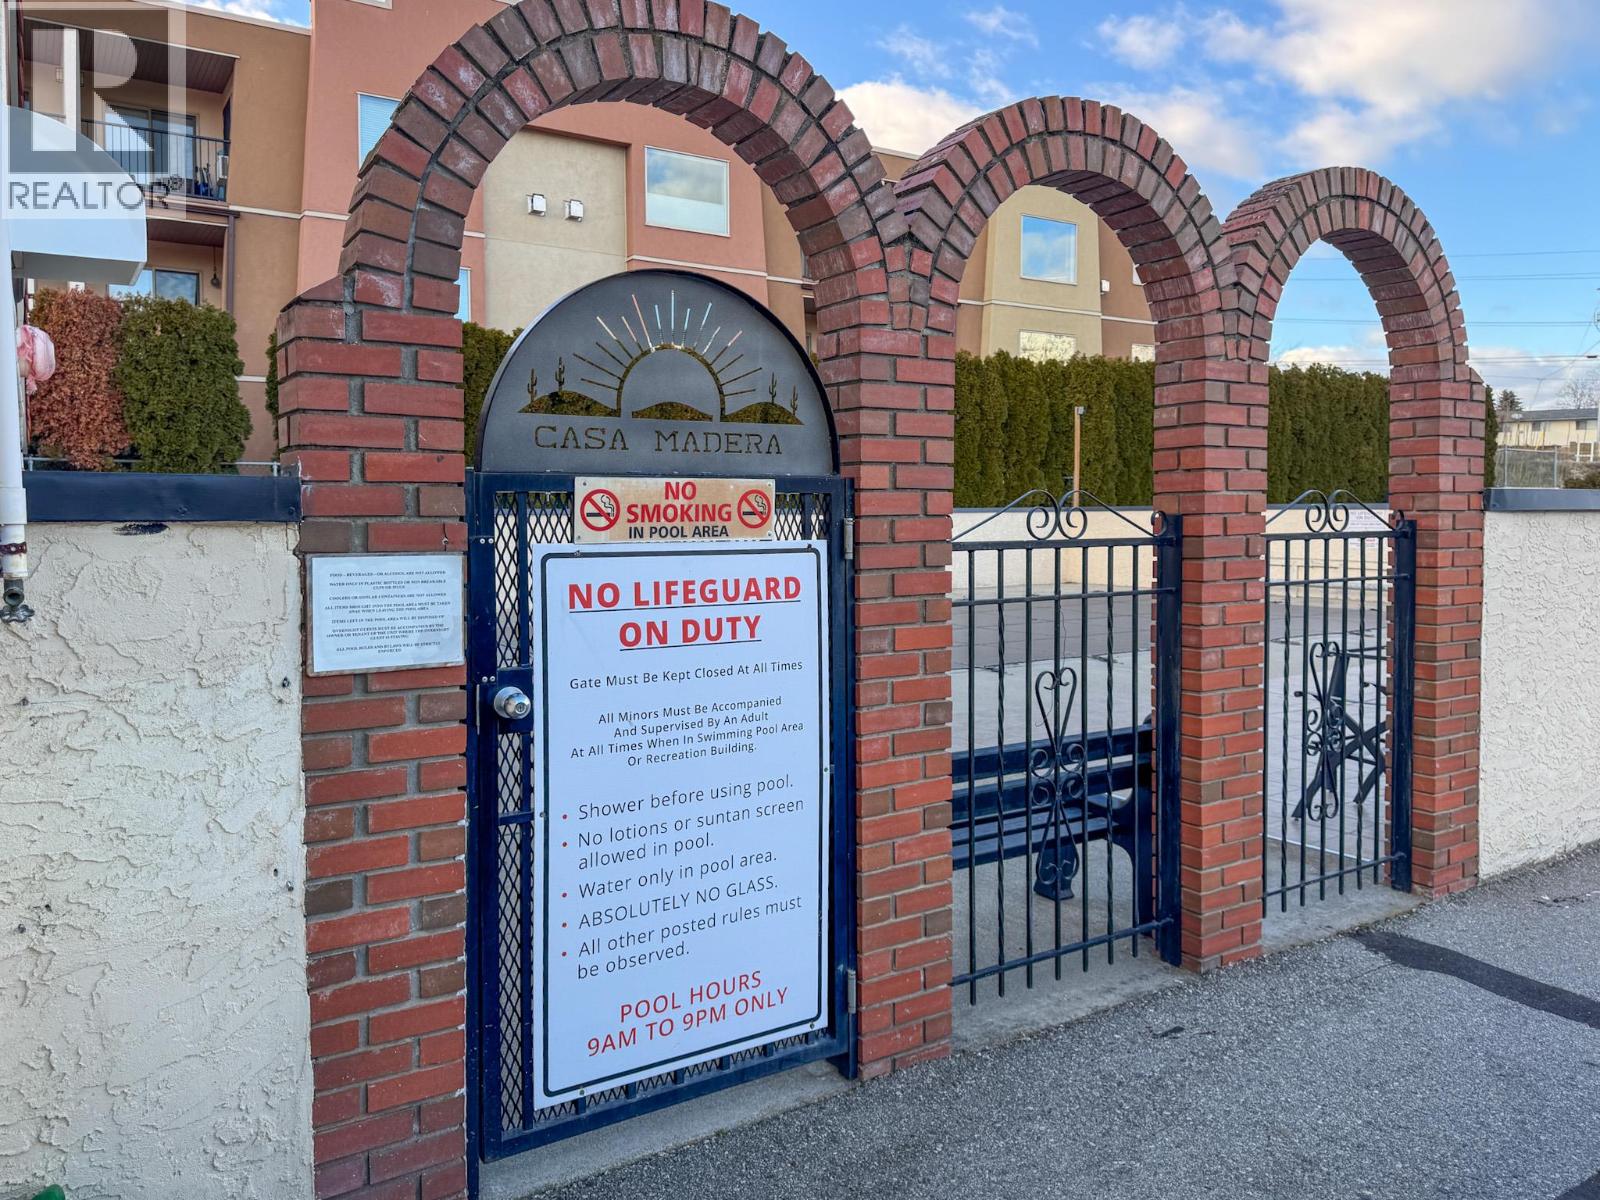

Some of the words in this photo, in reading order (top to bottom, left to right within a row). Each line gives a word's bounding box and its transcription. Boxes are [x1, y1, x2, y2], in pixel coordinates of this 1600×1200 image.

[535, 426, 629, 450] CASA
[654, 430, 782, 454] MADERA
[664, 481, 697, 501] NO
[626, 503, 731, 523] SMOKING
[629, 526, 644, 539] IN
[650, 526, 687, 538] POOL
[692, 526, 729, 537] AREA
[568, 583, 619, 608] NO
[634, 577, 799, 605] LIFEGUARD
[620, 622, 667, 647] ON
[682, 617, 759, 641] DUTY
[570, 678, 601, 689] Gate
[606, 675, 638, 686] Must
[644, 673, 658, 683] Be
[663, 670, 690, 683] Kept
[695, 665, 733, 678] Closed
[738, 665, 749, 674] At
[753, 663, 766, 674] All
[771, 662, 802, 672] Times
[599, 713, 613, 724] All
[619, 711, 658, 722] Minors
[663, 707, 690, 717] Must
[695, 705, 707, 714] Be
[712, 696, 781, 712] Accompanied
[614, 726, 636, 738] And
[641, 718, 703, 736] Supervised
[708, 718, 720, 729] By
[724, 716, 737, 725] An
[741, 712, 768, 723] Adult
[571, 748, 584, 758] At
[588, 744, 603, 756] All
[608, 742, 642, 754] Times
[647, 738, 679, 748] When
[684, 735, 693, 744] In
[698, 729, 752, 742] Swimming
[756, 724, 777, 736] Pool
[781, 723, 803, 732] Area
[628, 756, 642, 766] Or
[646, 749, 706, 764] Recreation
[711, 742, 756, 755] Building.
[579, 799, 644, 820] Shower
[651, 790, 704, 808] before
[711, 783, 751, 799] using
[758, 774, 792, 796] pool.
[579, 832, 602, 848] No
[610, 822, 667, 842] lotions
[674, 818, 691, 831] or
[697, 809, 750, 827] suntan
[756, 800, 803, 817] screen
[579, 844, 646, 870] allowed
[654, 842, 667, 856] in
[675, 832, 713, 856] pool.
[579, 878, 631, 898] Water
[638, 868, 673, 886] only
[680, 865, 693, 878] in
[701, 855, 733, 879] pool
[740, 852, 776, 867] area.
[579, 892, 690, 929] ABSOLUTELY
[697, 887, 720, 904] NO
[727, 876, 777, 897] GLASS.
[579, 938, 600, 958] All
[608, 930, 654, 950] other
[662, 912, 715, 943] posted
[723, 907, 759, 924] rules
[766, 896, 801, 915] must
[578, 964, 598, 979] be
[606, 941, 689, 972] observed.
[620, 993, 681, 1023] POOL
[690, 971, 763, 1004] HOURS
[586, 1028, 637, 1055] 9AM
[646, 1018, 675, 1039] TO
[682, 1004, 726, 1028] 9PM
[734, 989, 787, 1016] ONLY
